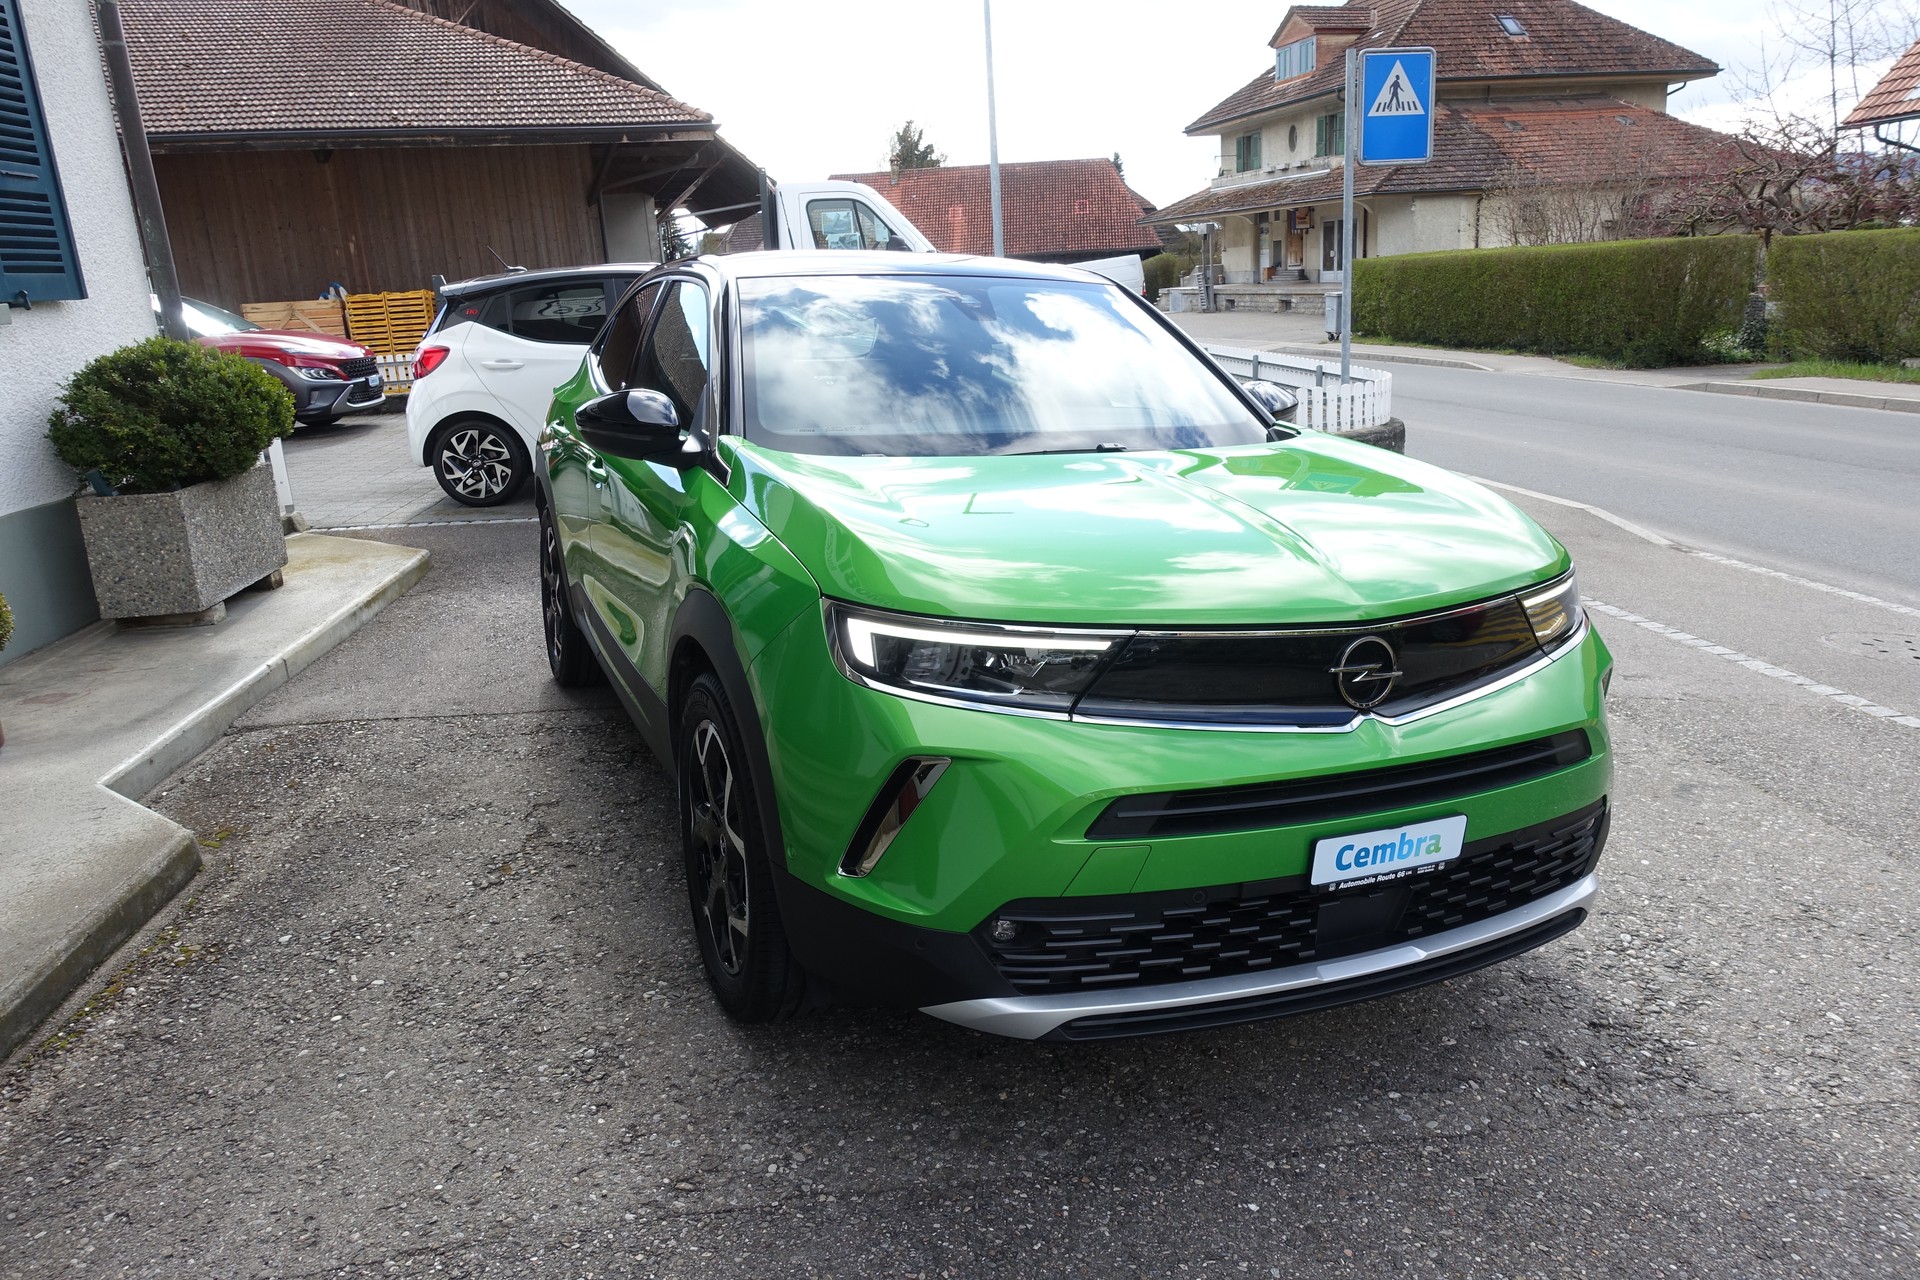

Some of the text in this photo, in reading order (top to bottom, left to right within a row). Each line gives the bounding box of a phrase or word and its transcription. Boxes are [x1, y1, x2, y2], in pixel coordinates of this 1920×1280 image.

[1335, 832, 1441, 871] Cembra
[1338, 876, 1375, 889] Automobile
[1376, 873, 1396, 883] Route
[1396, 870, 1406, 878] 66
